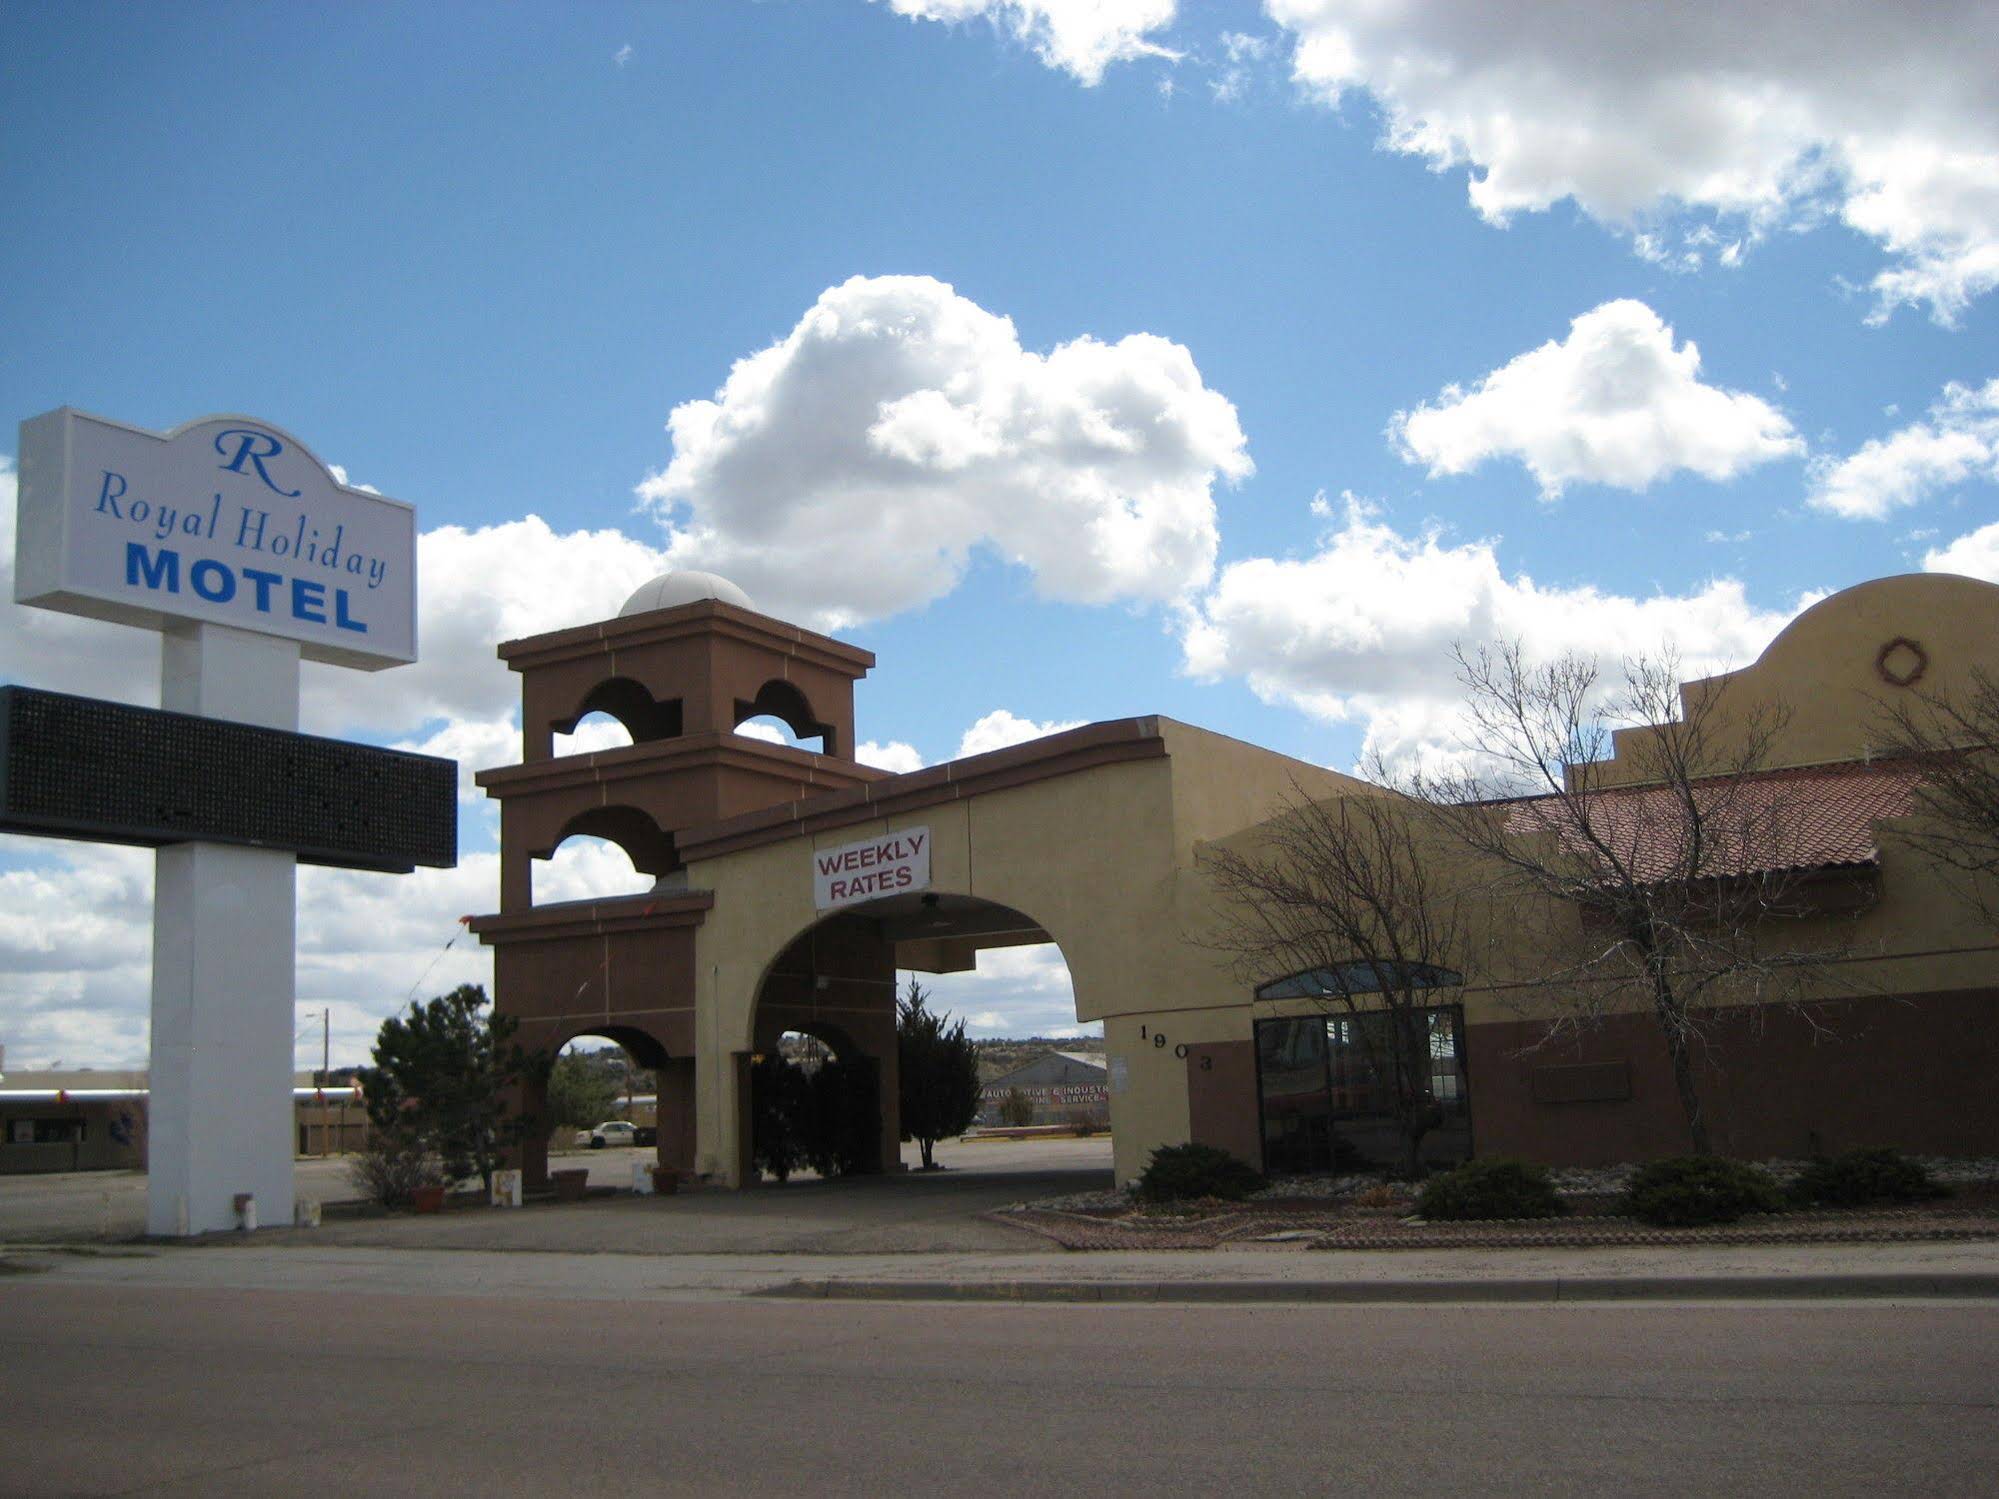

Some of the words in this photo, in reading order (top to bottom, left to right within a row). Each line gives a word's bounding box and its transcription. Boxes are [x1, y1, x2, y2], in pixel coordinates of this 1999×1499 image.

[215, 429, 302, 498] R
[95, 470, 220, 540] Royal
[235, 506, 387, 589] Holiday
[126, 541, 369, 634] MOTEL
[818, 834, 925, 876] WEEKLY
[831, 866, 913, 901] RATES
[1140, 1024, 1213, 1072] 1903
